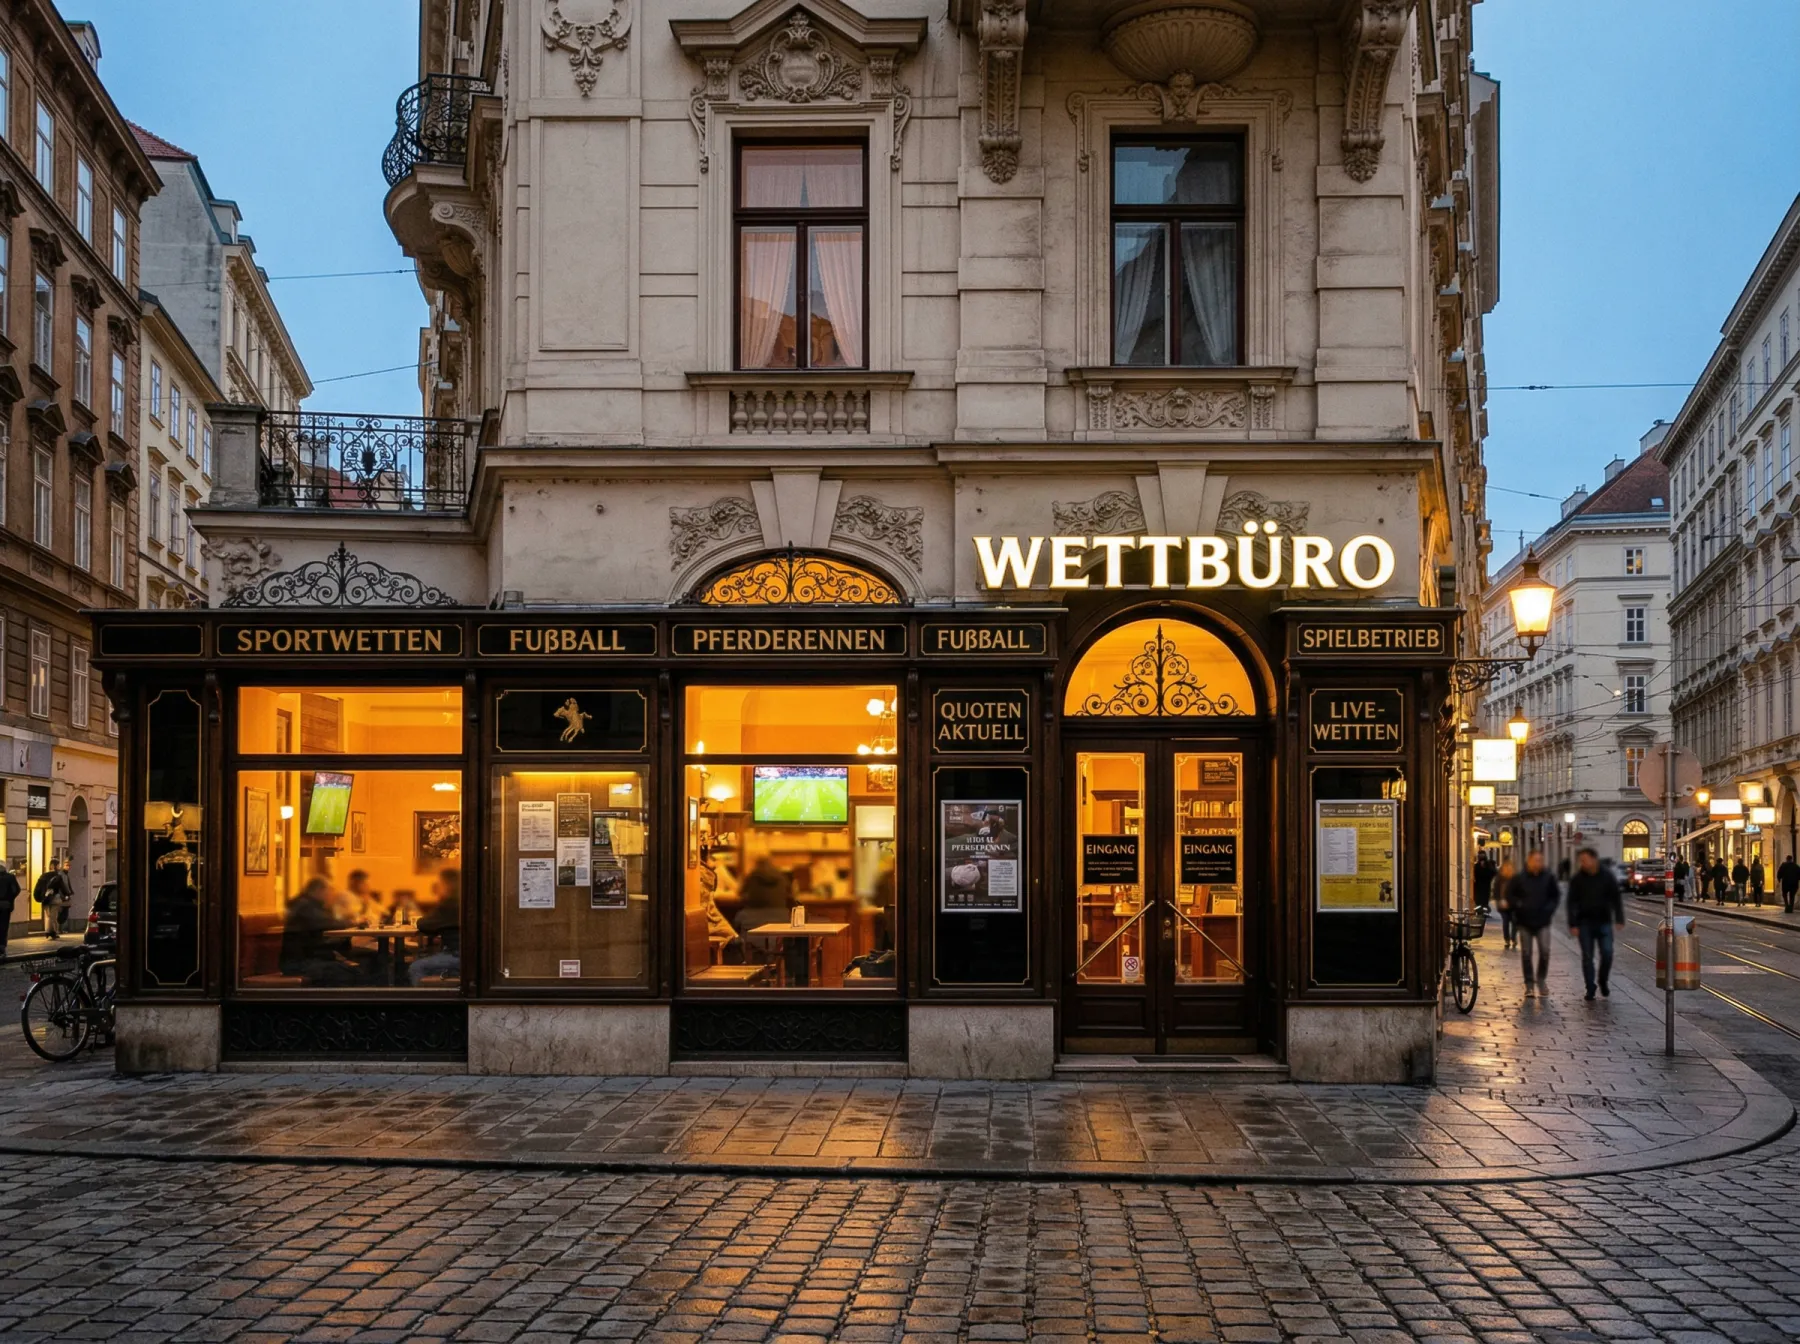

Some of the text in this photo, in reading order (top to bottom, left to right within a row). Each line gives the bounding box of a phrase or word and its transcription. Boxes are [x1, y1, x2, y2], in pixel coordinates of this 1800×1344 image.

[973, 520, 1396, 589] WETTBÜRO
[236, 629, 443, 652] SPORTWETTEN
[692, 629, 887, 651] PFERDERENNEN
[1303, 629, 1440, 648] SPIELBETRIEB
[941, 702, 1021, 721] QUOTEN
[1330, 701, 1385, 719] LIVE-
[938, 724, 1024, 740] AKTUELL
[1314, 724, 1399, 740] WETTTEN
[1086, 844, 1135, 855] EINGANG
[1184, 844, 1233, 855] EINGANG
